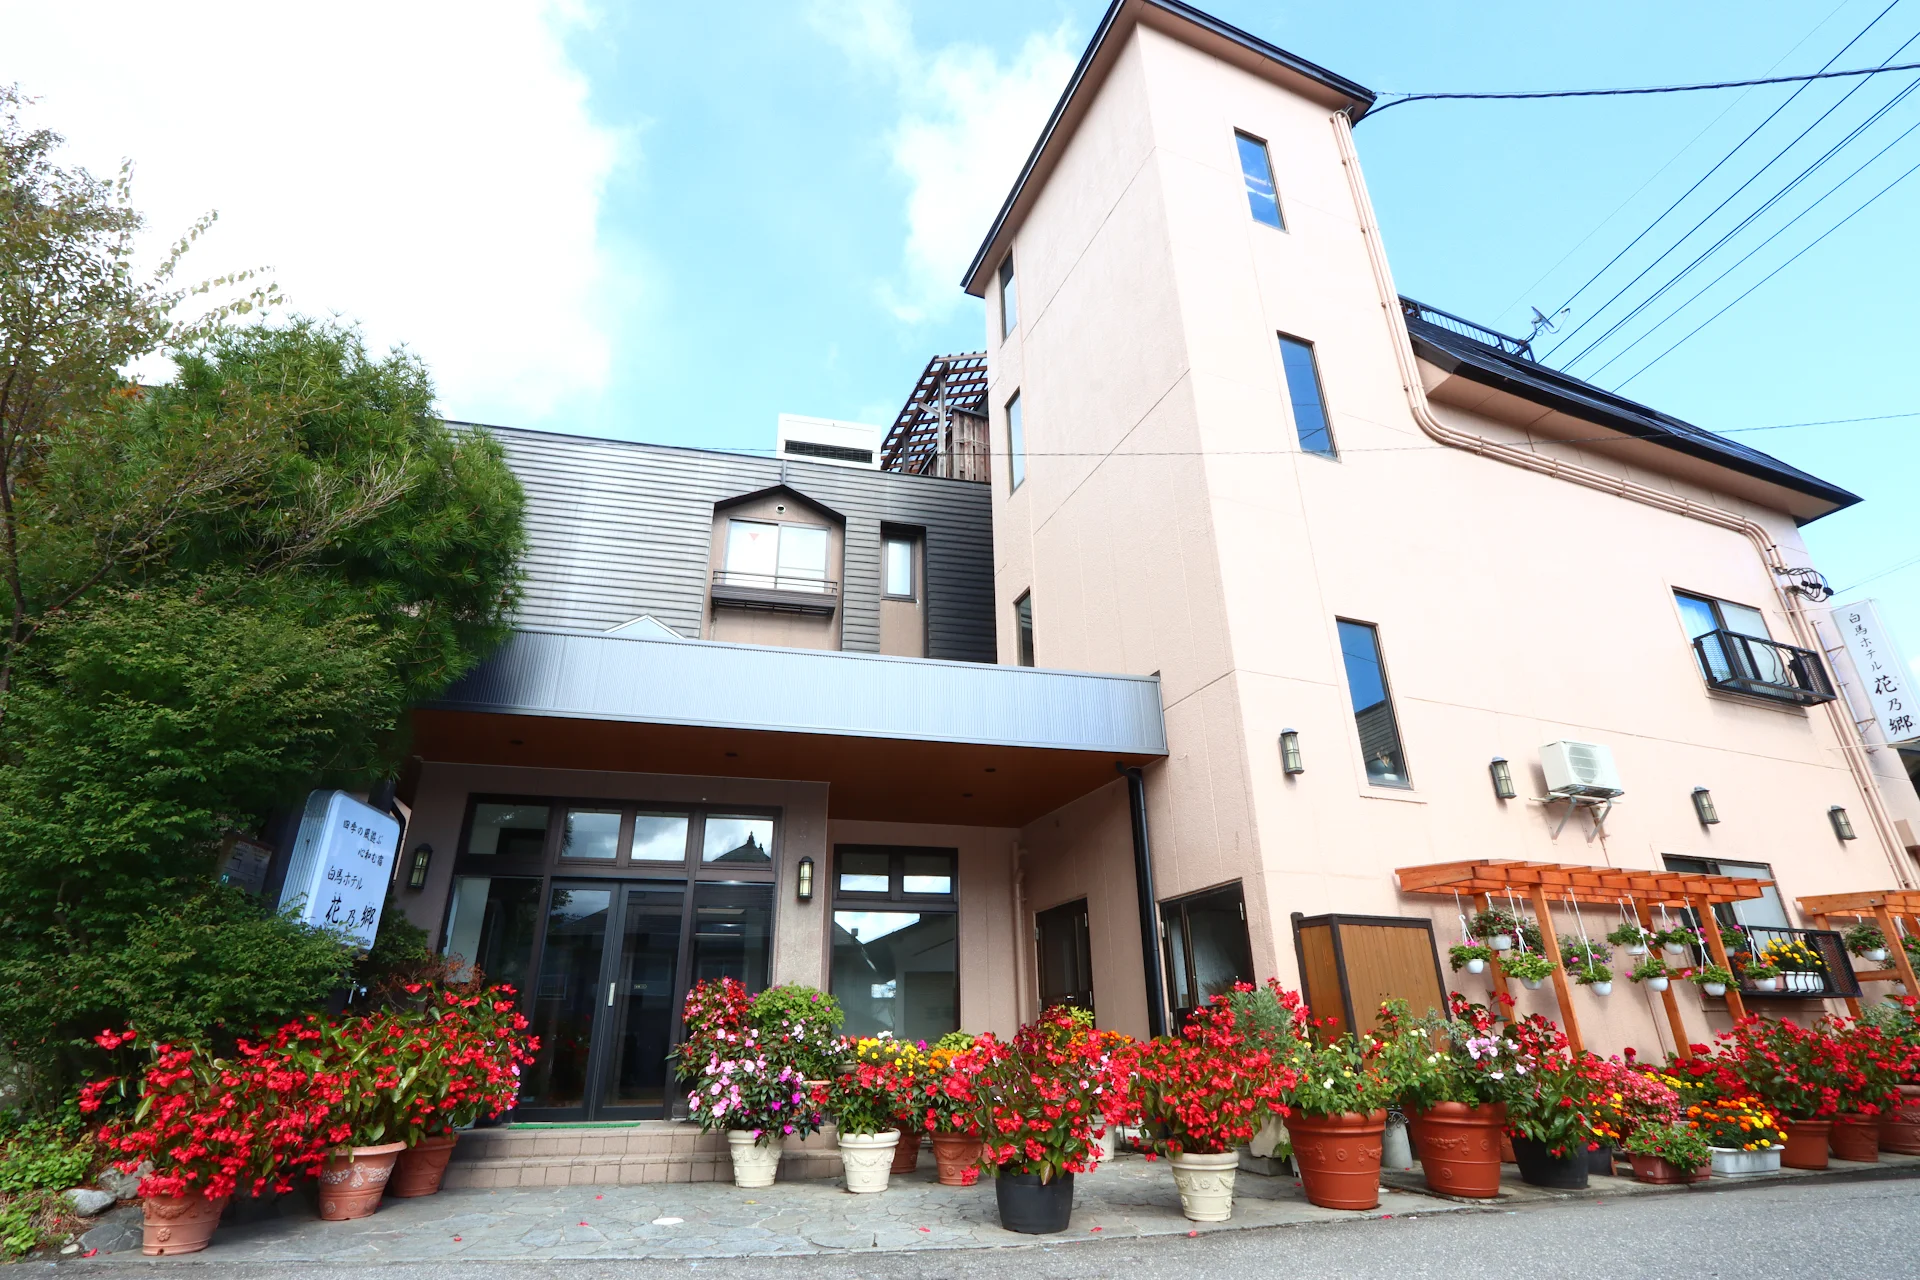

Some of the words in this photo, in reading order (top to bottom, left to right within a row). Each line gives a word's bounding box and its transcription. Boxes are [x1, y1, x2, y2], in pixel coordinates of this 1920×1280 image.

[327, 865, 363, 890] 白馬ホテル
[325, 896, 376, 931] 花乃郷
